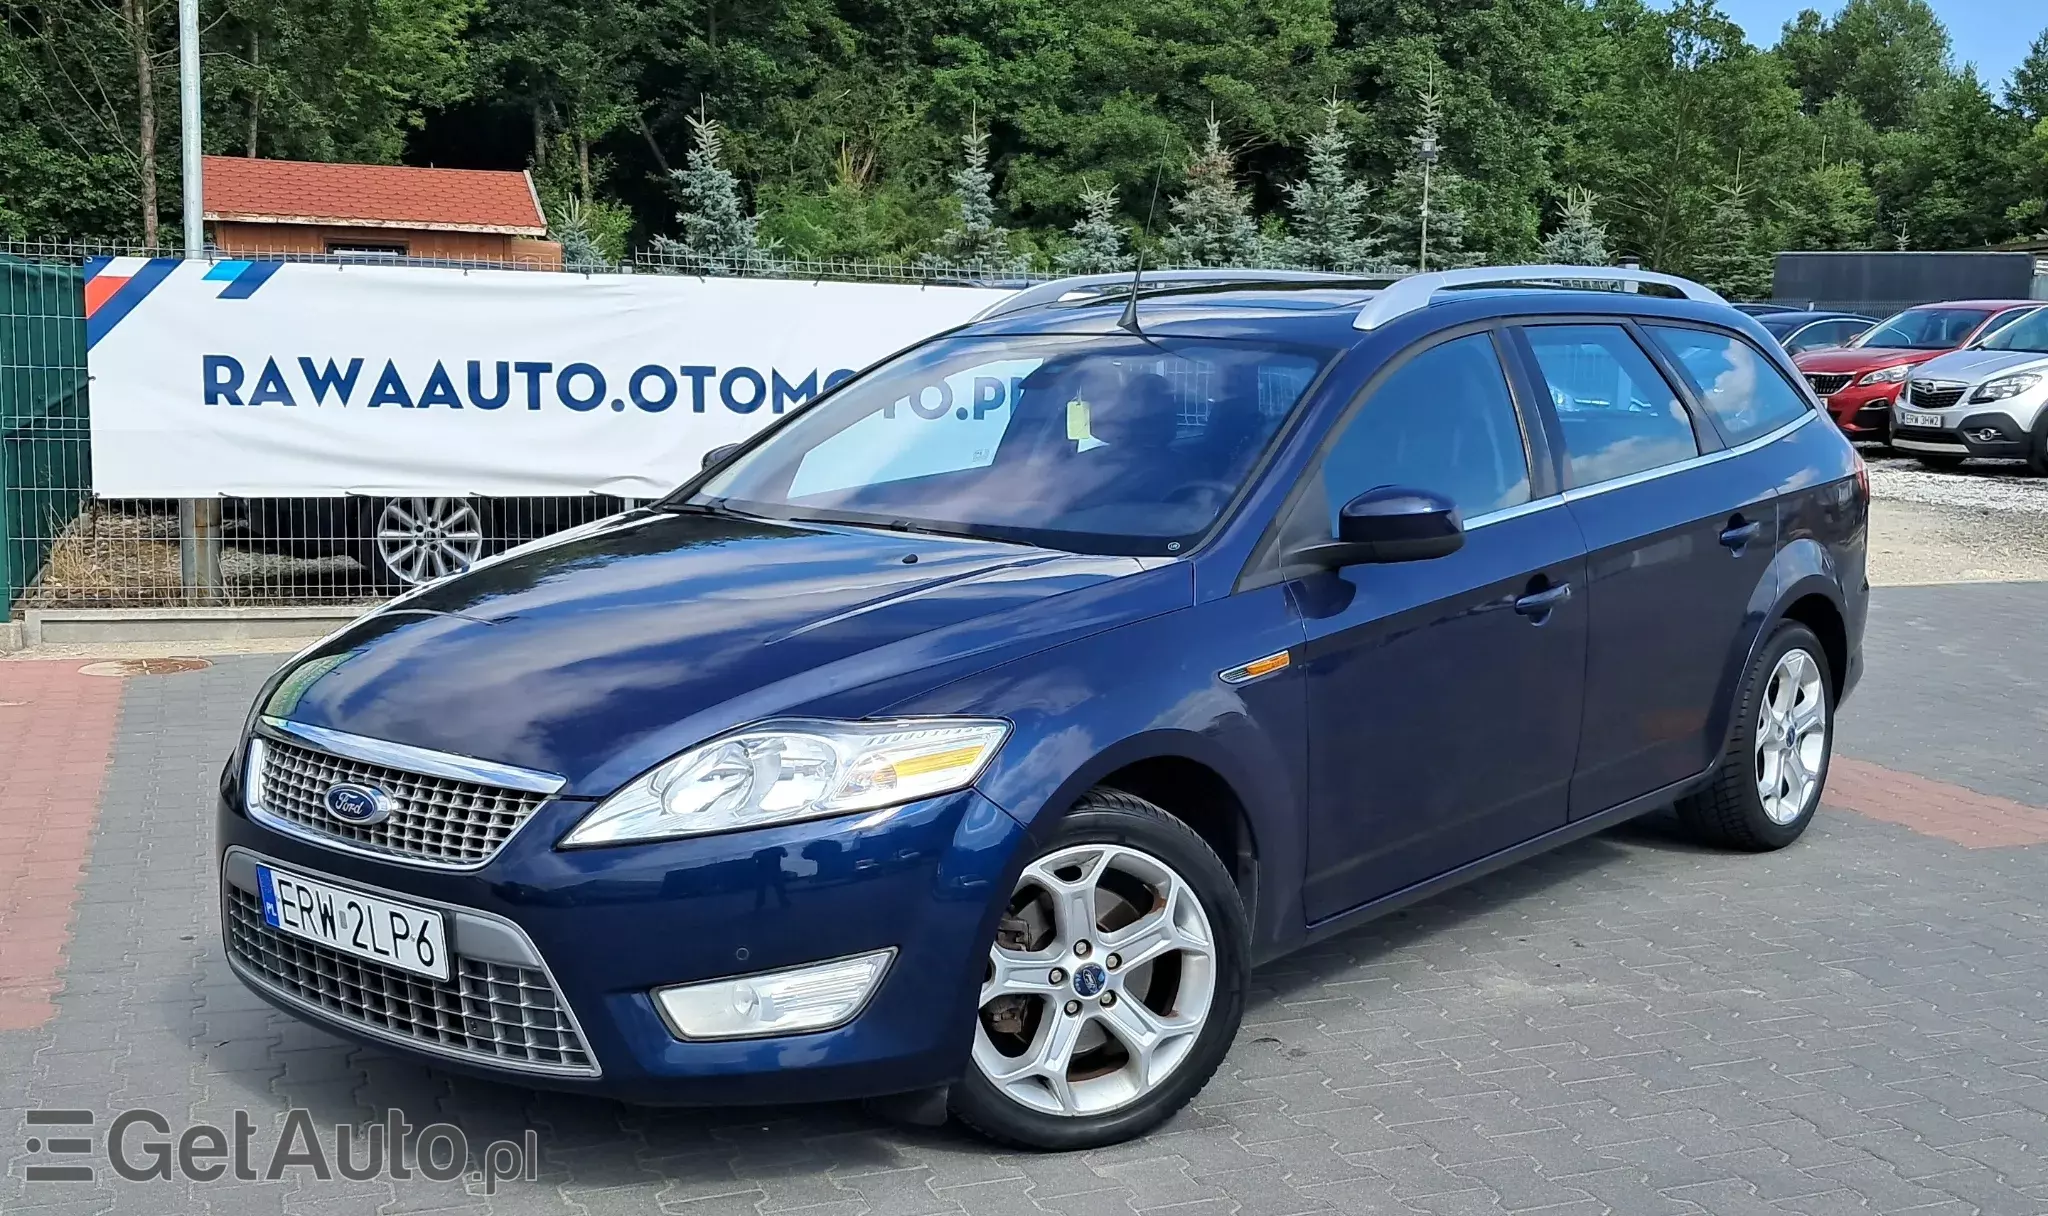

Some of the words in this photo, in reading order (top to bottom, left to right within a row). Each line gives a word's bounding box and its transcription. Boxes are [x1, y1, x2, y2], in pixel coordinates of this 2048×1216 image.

[1906, 414, 1918, 424] ERW
[335, 792, 364, 815] Ford
[266, 901, 277, 917] PL
[277, 878, 337, 941] ERW
[347, 901, 434, 967] 2LP6
